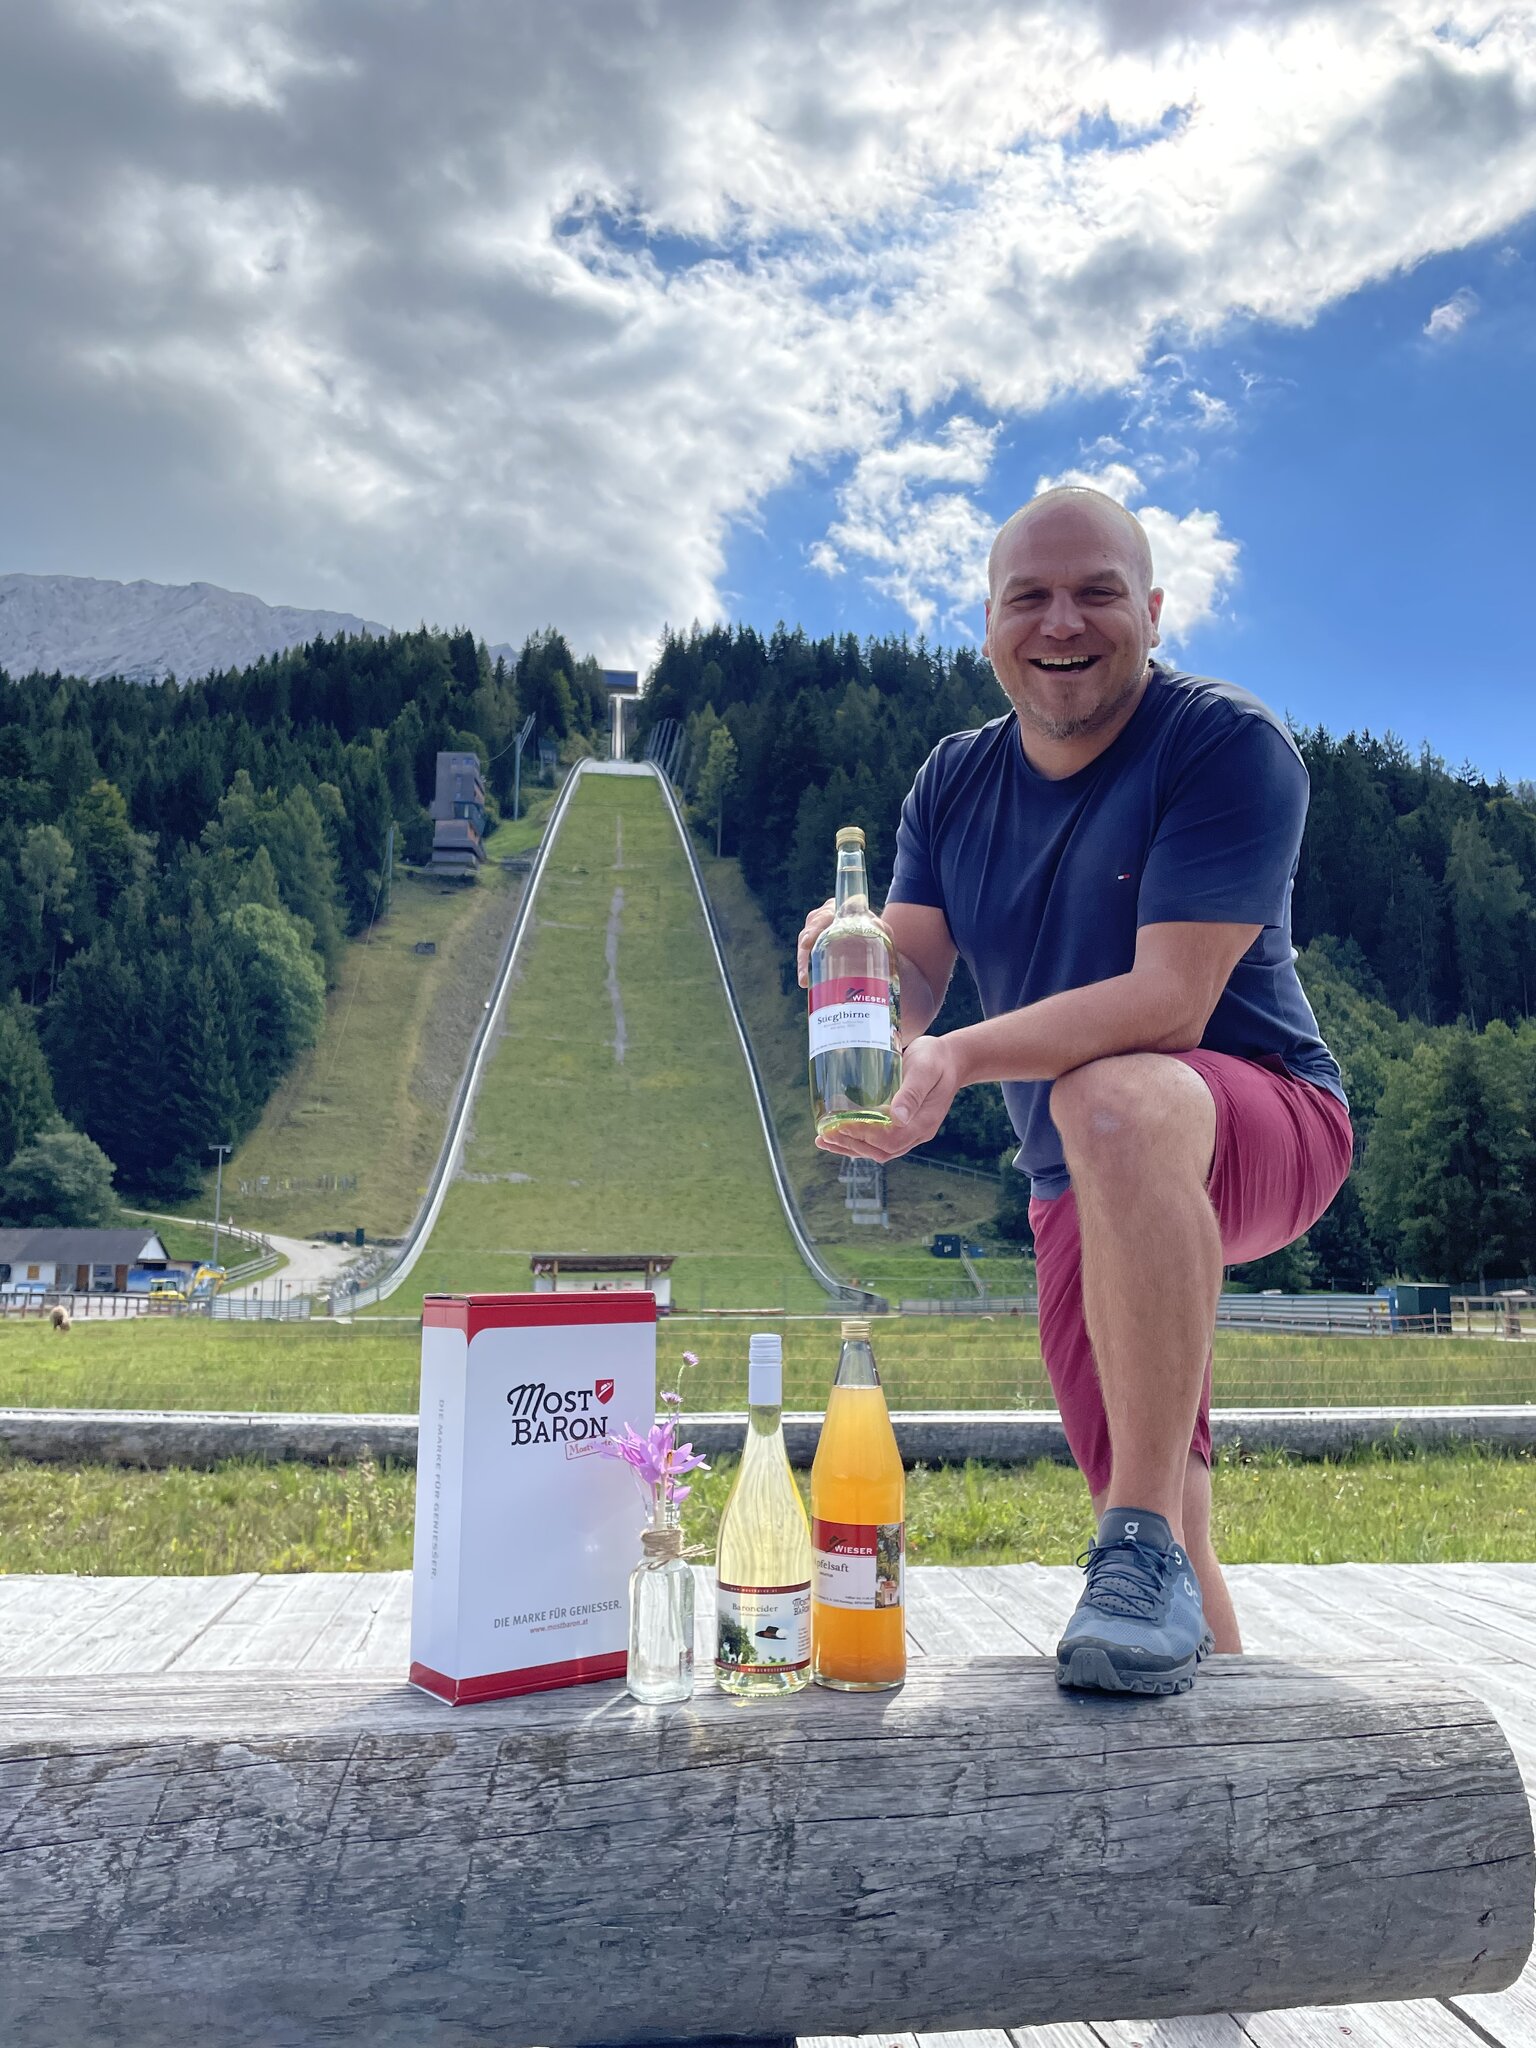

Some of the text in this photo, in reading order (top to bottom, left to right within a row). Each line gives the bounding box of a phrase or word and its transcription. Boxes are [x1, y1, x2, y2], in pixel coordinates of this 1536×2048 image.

[852, 994, 887, 1004] WIESER
[817, 1010, 870, 1025] Stieglbirne
[507, 1383, 593, 1422] MOST
[511, 1416, 608, 1446] BARON
[834, 1544, 873, 1555] WIESER
[816, 1558, 849, 1573] pfelsaft
[494, 1599, 622, 1629] DIE MARKE FÜR GENIESSER.
[530, 1618, 588, 1634] www.mostbaron.at
